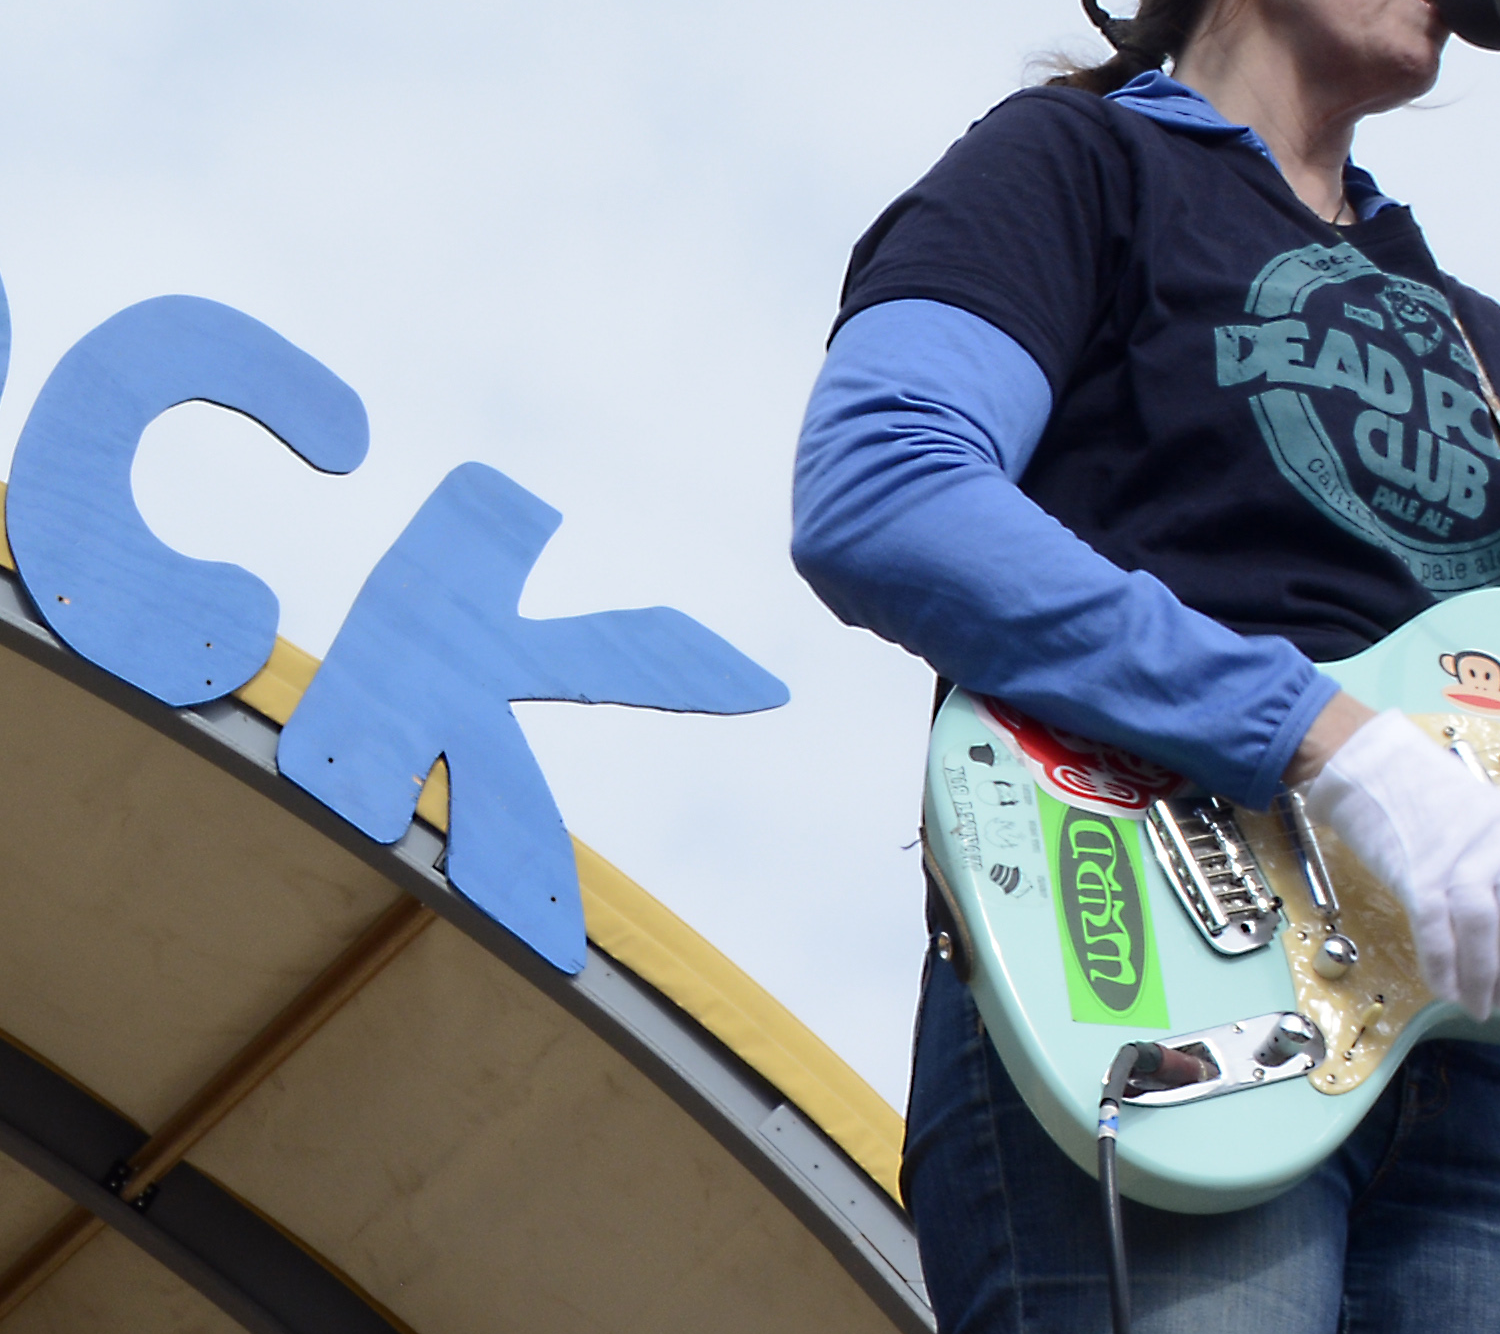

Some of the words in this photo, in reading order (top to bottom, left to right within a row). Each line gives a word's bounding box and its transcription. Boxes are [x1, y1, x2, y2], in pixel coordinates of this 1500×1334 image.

[1214, 319, 1413, 415] DEAD
[1354, 409, 1490, 520] CLUB
[1370, 484, 1421, 526] PALE
[1416, 507, 1455, 538] ALE
[1420, 558, 1468, 585] pale
